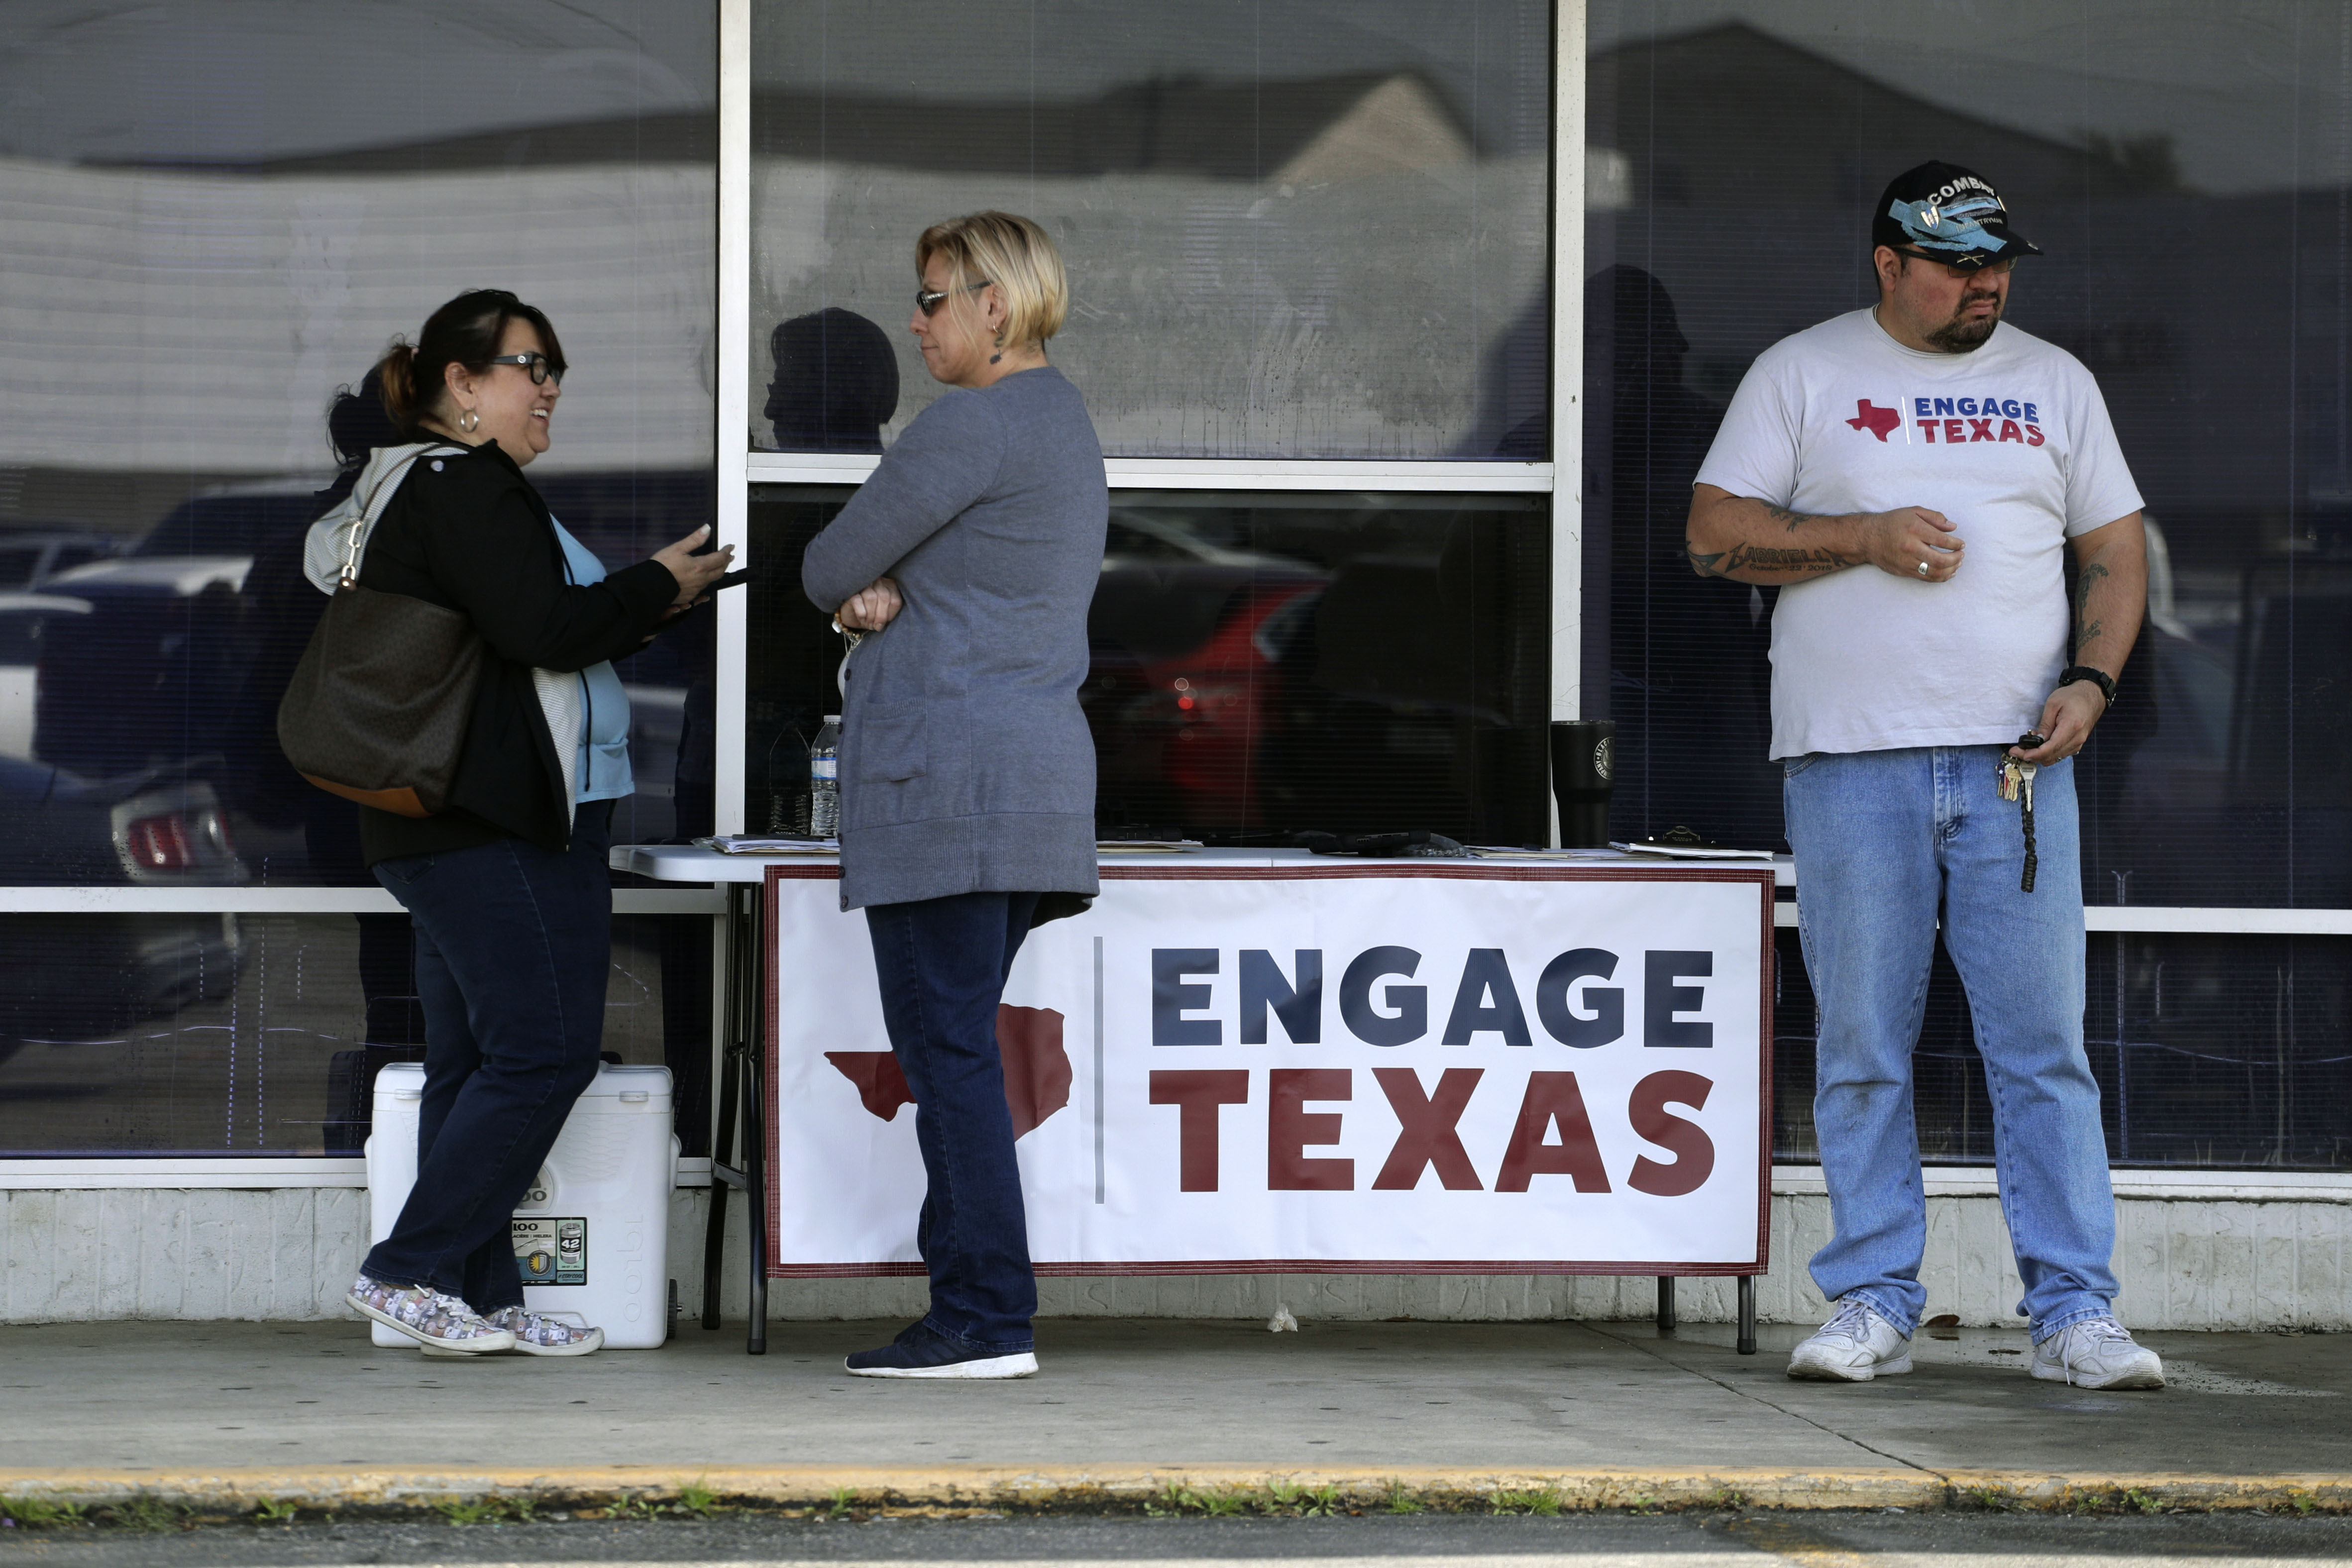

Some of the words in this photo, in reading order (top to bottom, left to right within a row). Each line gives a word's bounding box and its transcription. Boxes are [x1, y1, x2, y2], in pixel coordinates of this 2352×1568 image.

[1915, 398, 2039, 423] ENGAGE
[1917, 418, 2045, 446] TEXAS
[1152, 945, 1713, 1048] ENGAGE
[1149, 1068, 1715, 1197] TEXAS
[561, 1239, 580, 1249] 42
